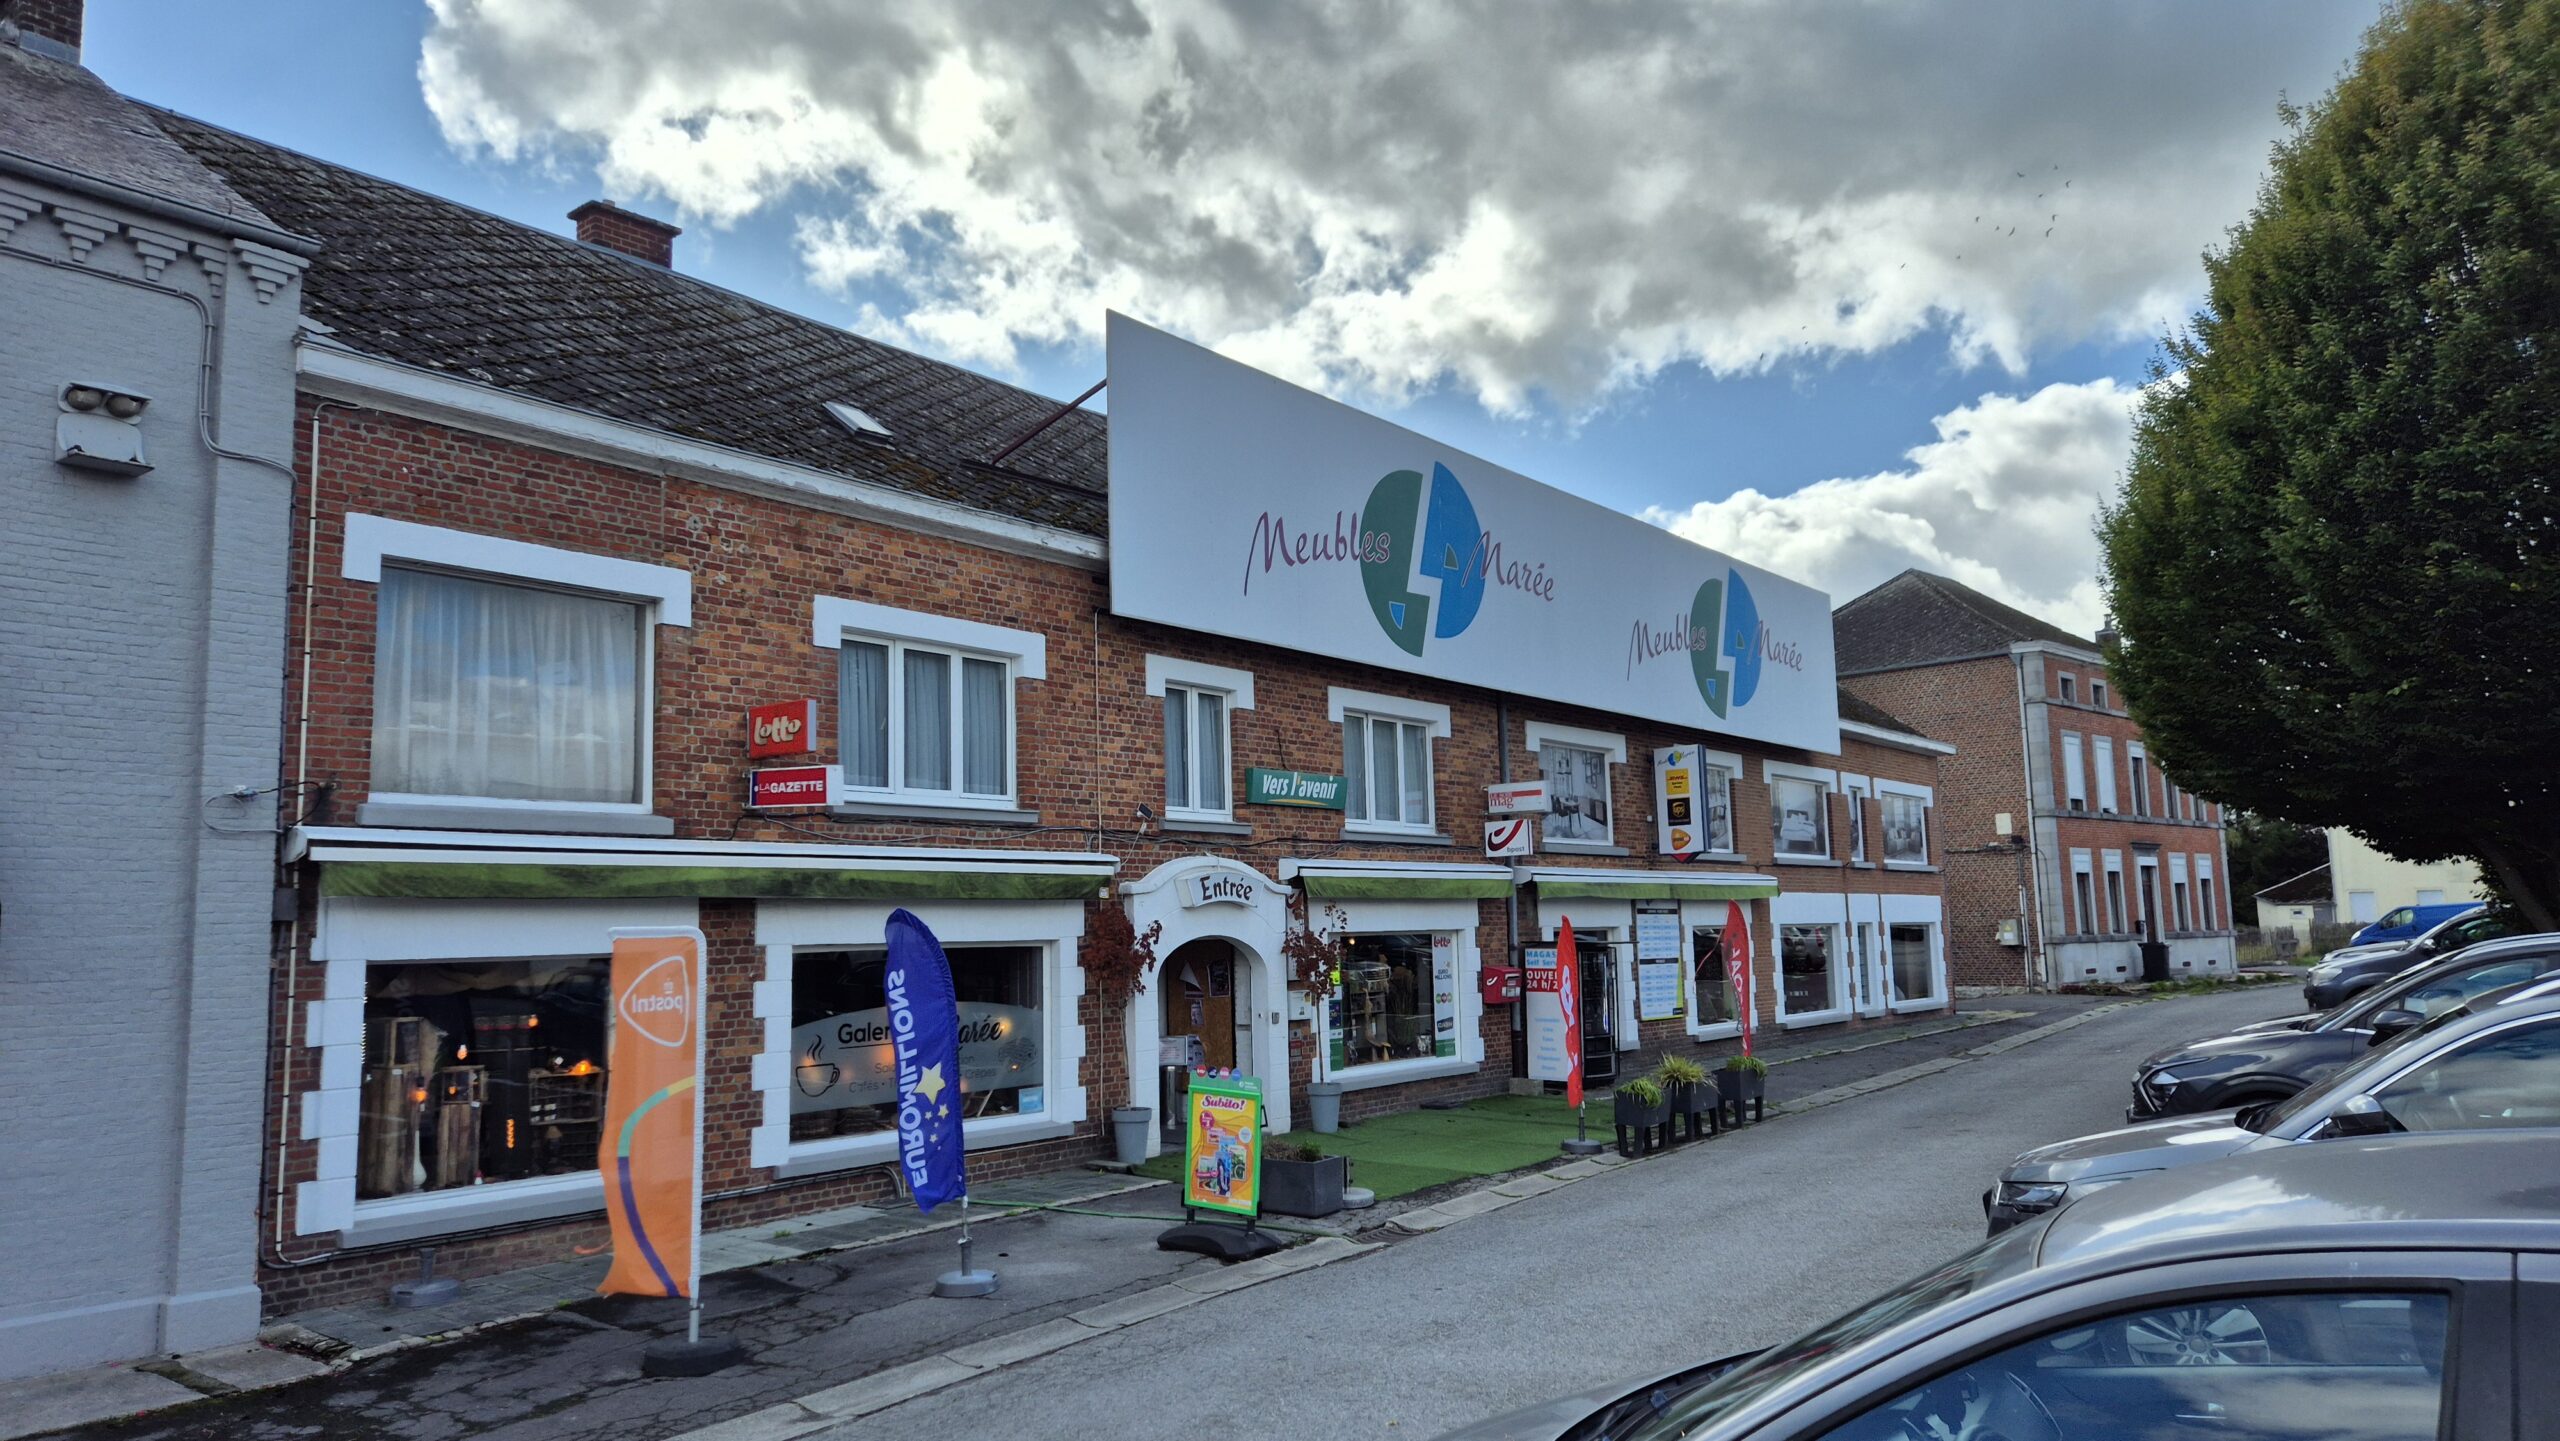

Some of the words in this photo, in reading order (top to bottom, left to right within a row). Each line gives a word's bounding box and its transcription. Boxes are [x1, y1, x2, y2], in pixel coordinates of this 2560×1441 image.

[1244, 511, 1391, 597] Meubles
[1461, 530, 1554, 602] Marée
[1627, 613, 1707, 681] Meubles
[1747, 619, 1802, 672] Marée
[759, 783, 770, 791] LA
[770, 780, 824, 793] GAZETTE
[1263, 774, 1289, 796] Vers
[1290, 771, 1338, 799] l'avenir
[1490, 798, 1514, 809] mag
[1200, 875, 1253, 901] Entrée
[1526, 980, 1538, 989] 24
[956, 1014, 1003, 1044] arée
[1202, 1095, 1245, 1110] Subito!
